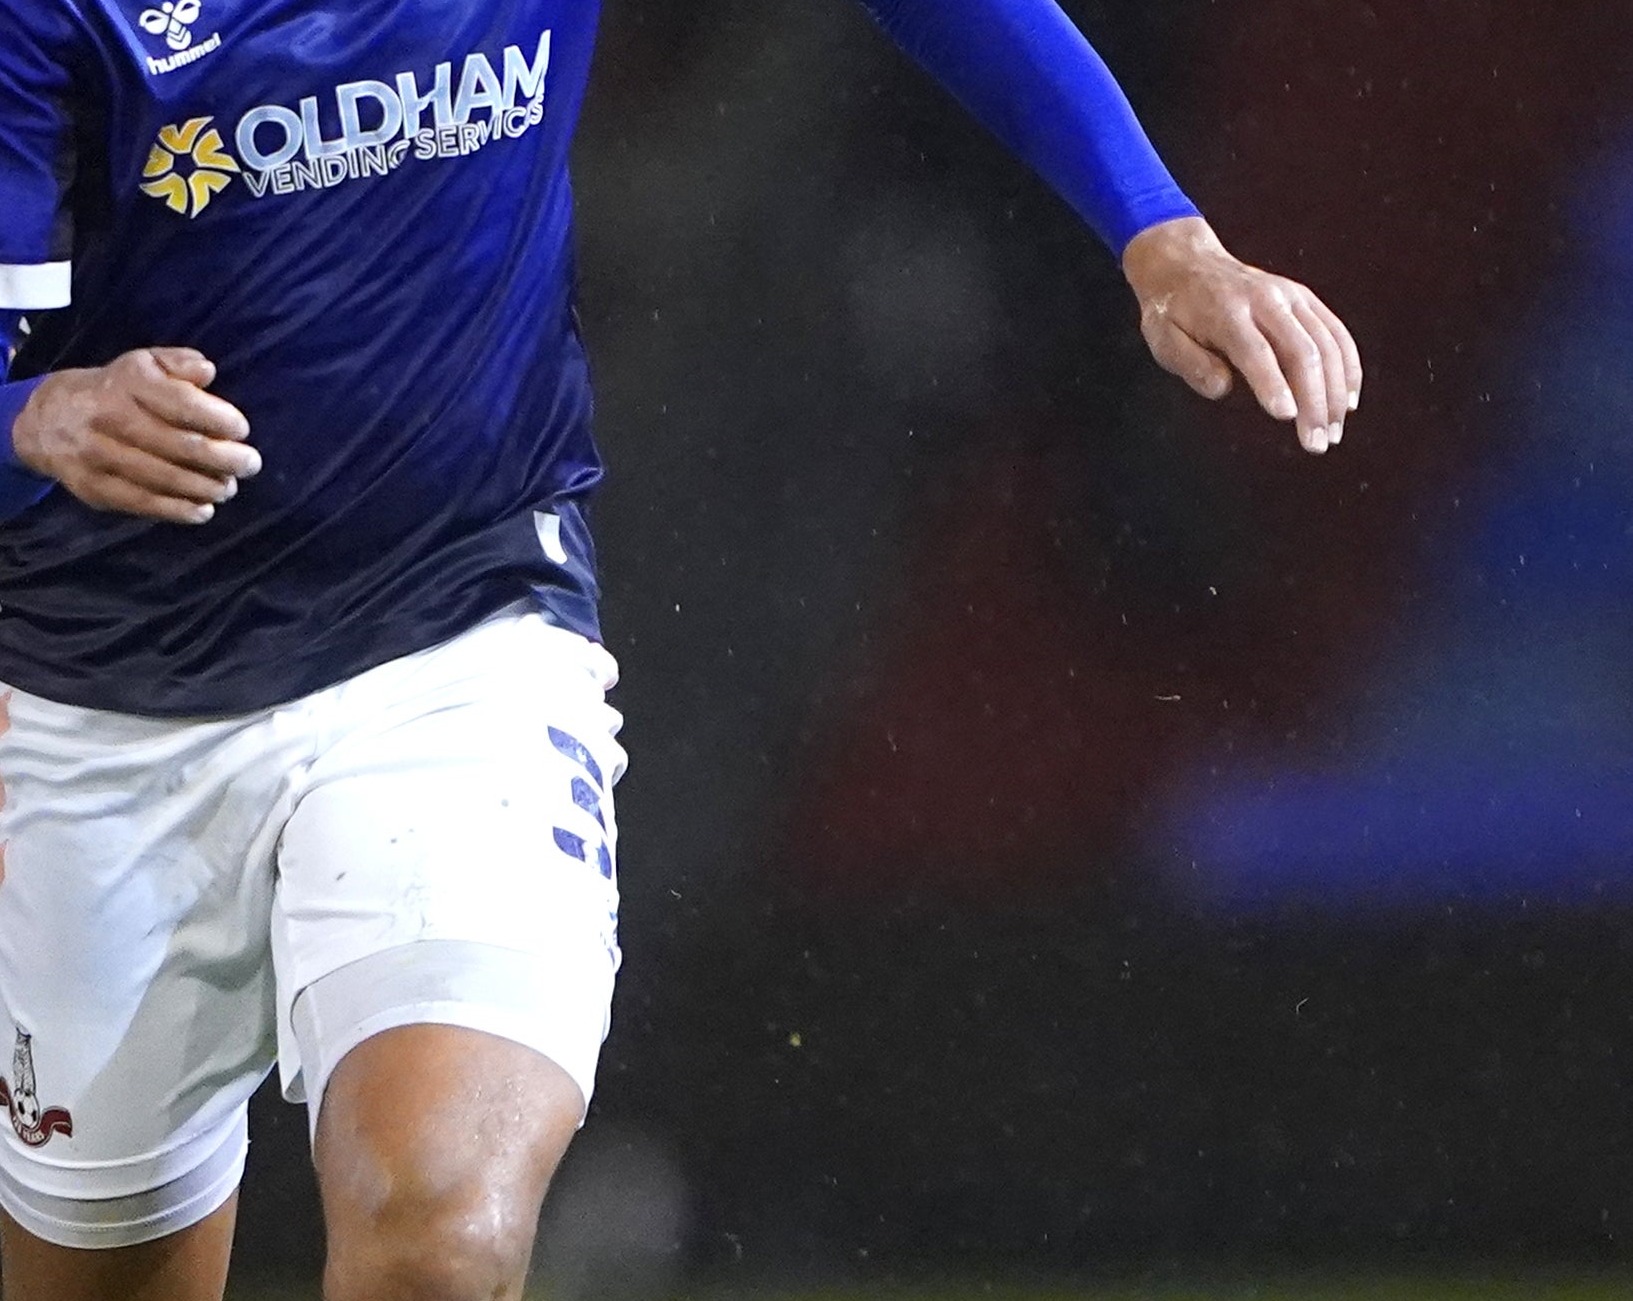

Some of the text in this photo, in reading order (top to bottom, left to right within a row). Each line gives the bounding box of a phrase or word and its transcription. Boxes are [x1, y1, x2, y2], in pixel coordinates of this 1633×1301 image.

[146, 31, 222, 76] hummel
[235, 28, 552, 172] OLDHAM
[414, 93, 545, 161] SERVICS
